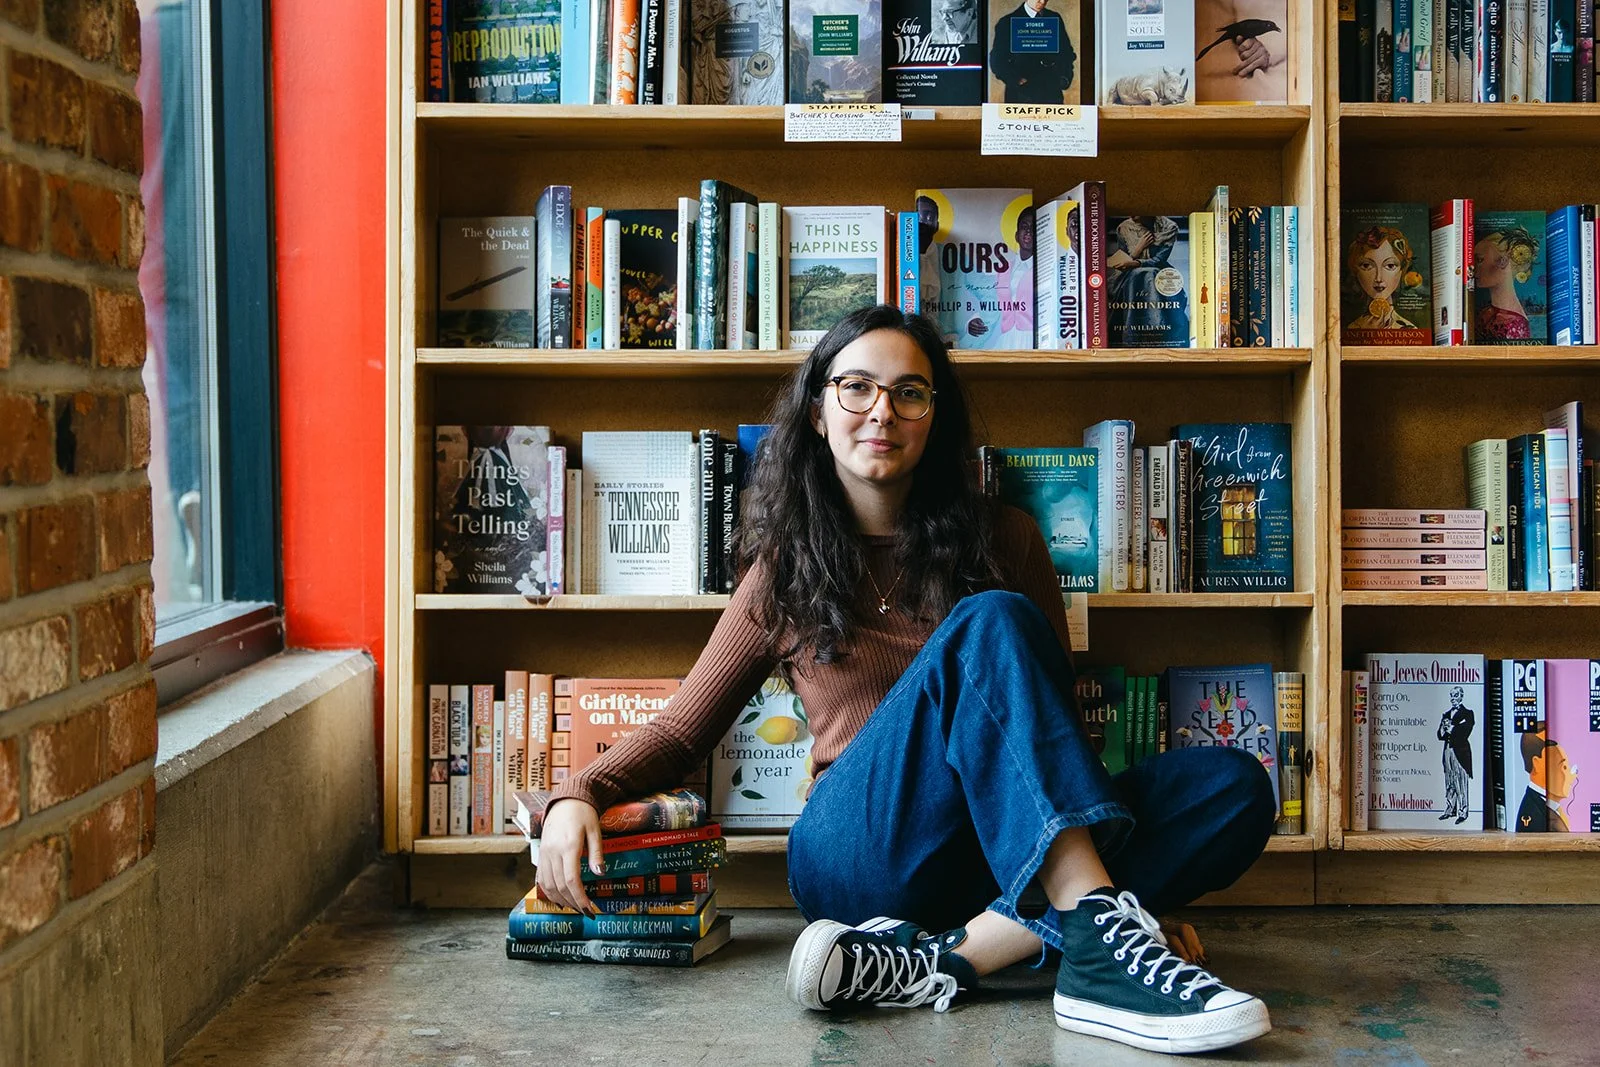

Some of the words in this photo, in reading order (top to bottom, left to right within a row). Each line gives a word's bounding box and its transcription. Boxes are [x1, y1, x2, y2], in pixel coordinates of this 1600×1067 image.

[648, 10, 658, 45] Powder
[892, 17, 921, 36] John
[1130, 26, 1162, 35] SOULS
[1418, 18, 1429, 42] Grief
[648, 46, 656, 68] Man
[894, 36, 966, 66] Williams
[430, 31, 442, 88] SWEET
[468, 77, 489, 88] IAN
[491, 72, 551, 87] WILLIAMS
[998, 123, 1054, 132] STONER
[462, 227, 482, 237] The
[486, 226, 518, 238] Quick
[520, 228, 530, 237] &
[806, 224, 840, 236] THIS
[847, 224, 860, 236] IS
[480, 240, 498, 250] the
[502, 240, 530, 250] Dead
[790, 241, 878, 253] HAPPINESS
[942, 242, 1010, 274] OURS
[1070, 284, 1076, 293] B.
[1572, 266, 1580, 296] JEANETTE
[926, 301, 962, 311] PHILLIP
[966, 301, 976, 311] B.
[980, 301, 1026, 311] WILLIAMS
[731, 312, 737, 322] OF
[1060, 295, 1078, 340] OURS
[1116, 431, 1125, 460] BAND
[1190, 436, 1206, 448] The
[1202, 427, 1248, 469] Girl
[1246, 446, 1271, 462] from
[1532, 440, 1540, 455] THE
[1007, 455, 1065, 467] BEAUTIFUL
[1069, 454, 1095, 466] DAYS
[1116, 461, 1125, 471] of
[1134, 456, 1142, 478] BAND
[453, 460, 530, 485] Things
[1153, 458, 1161, 490] EMERALD
[1192, 454, 1286, 492] Greenwich
[1134, 480, 1142, 489] of
[467, 486, 515, 507] Past
[724, 484, 734, 510] TOWN
[1116, 476, 1125, 511] SISTERS
[1153, 491, 1161, 508] RING
[608, 492, 679, 521] TENNESSEE
[1200, 489, 1268, 520] Street
[1509, 505, 1517, 526] CZAR
[453, 514, 530, 540] Telling
[723, 513, 733, 554] BURNING
[608, 524, 670, 553] WILLIAMS
[474, 562, 506, 572] Sheila
[467, 573, 512, 584] Williams
[1370, 660, 1389, 682] The
[1393, 660, 1427, 684] Jeeves
[1431, 660, 1480, 682] Omnibus
[1200, 680, 1246, 698] THE
[1372, 692, 1394, 702] Carry
[1396, 692, 1410, 702] On,
[432, 698, 440, 714] PINK
[451, 700, 461, 724] BLACK
[1372, 703, 1399, 712] Jeeves
[1191, 709, 1257, 729] SEED
[1372, 718, 1387, 726] The
[1388, 717, 1427, 727] Inimitable
[432, 716, 440, 754] CARNATION
[451, 727, 460, 747] TULIP
[734, 731, 756, 743] the
[1372, 728, 1399, 736] Jeeves
[720, 744, 805, 760] lemonade
[1372, 743, 1386, 751] Stiff
[1388, 743, 1412, 753] Upper
[1414, 743, 1427, 753] Lip,
[1372, 752, 1399, 760] Jeeves
[753, 767, 792, 783] year
[1372, 793, 1377, 808] P.
[1379, 793, 1387, 809] G.
[1389, 794, 1433, 809] Wodehouse
[657, 851, 692, 860] KRISTIN
[614, 860, 639, 870] Lane
[656, 859, 693, 869] HANNAH
[607, 901, 636, 912] FREDRIK
[640, 901, 674, 912] BACKMAN
[525, 922, 539, 934] MY
[541, 922, 572, 934] FRIENDS
[597, 922, 630, 934] FREDRIK
[633, 921, 672, 934] BACKMAN
[512, 943, 546, 953] LINCOLN
[601, 947, 630, 959] GEORGE
[633, 948, 670, 959] SAUNDERS
